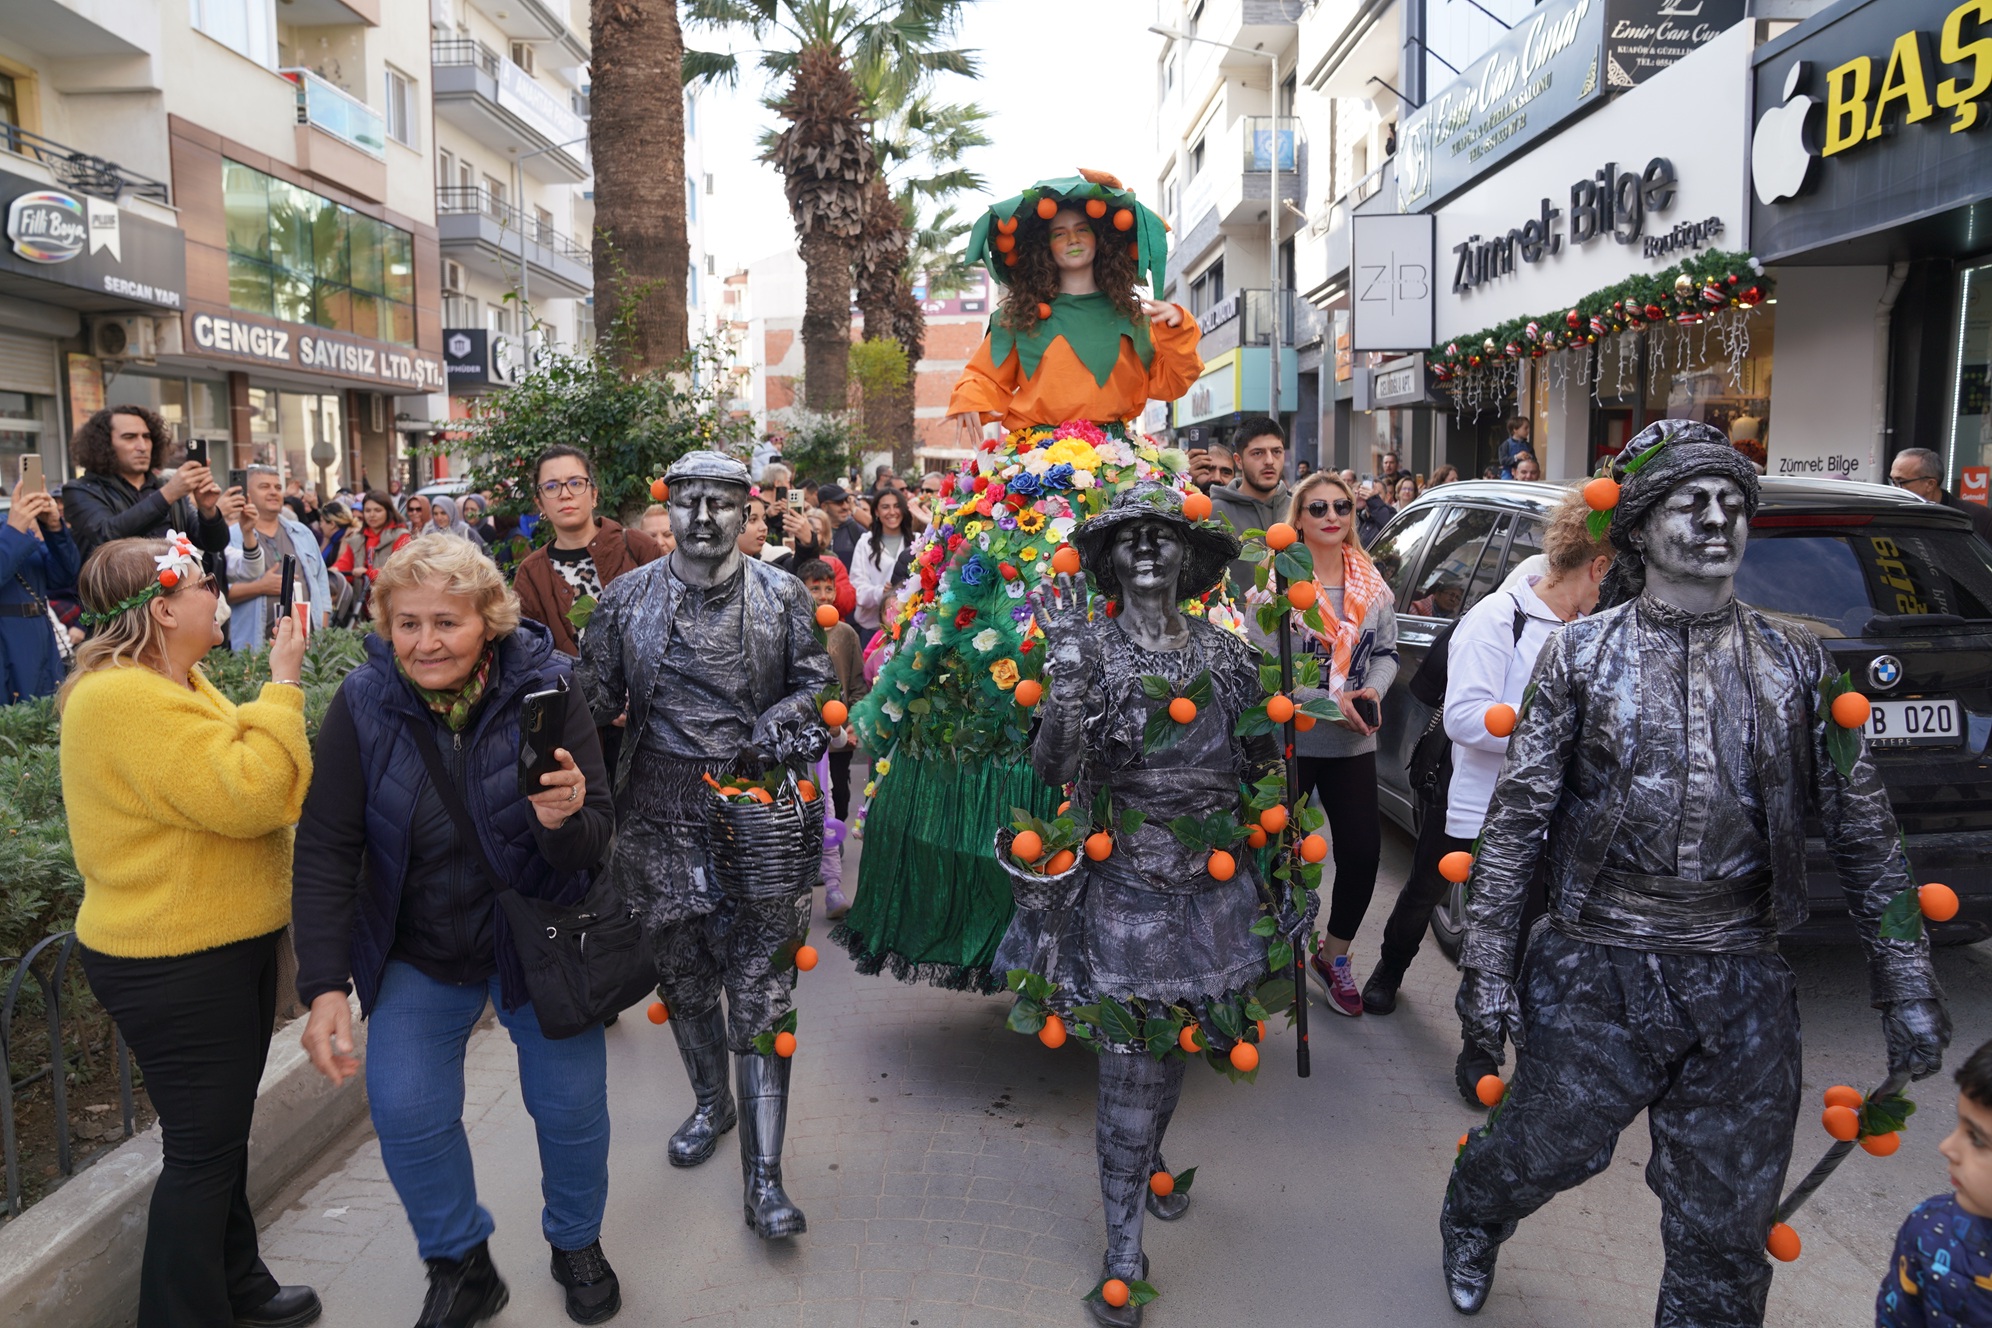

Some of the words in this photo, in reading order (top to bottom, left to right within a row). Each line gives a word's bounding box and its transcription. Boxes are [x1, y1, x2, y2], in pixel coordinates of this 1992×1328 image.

[1611, 20, 1656, 40] Emir
[1656, 21, 1691, 41] Can
[1822, 0, 1992, 158] BAŞ
[21, 208, 48, 235] Filli
[49, 211, 87, 246] Boya
[1452, 197, 1564, 294] Zümret
[1570, 157, 1679, 246] Bilge
[1643, 216, 1726, 259] Boutique
[104, 275, 153, 300] SERCAN
[154, 287, 180, 306] YAPI
[300, 336, 376, 375] SAYISIZ
[1779, 457, 1824, 474] Zümret
[1827, 455, 1859, 475] Bilge
[1962, 492, 1986, 501] Getmobil
[1863, 707, 1887, 735] B
[1904, 705, 1952, 733] 020
